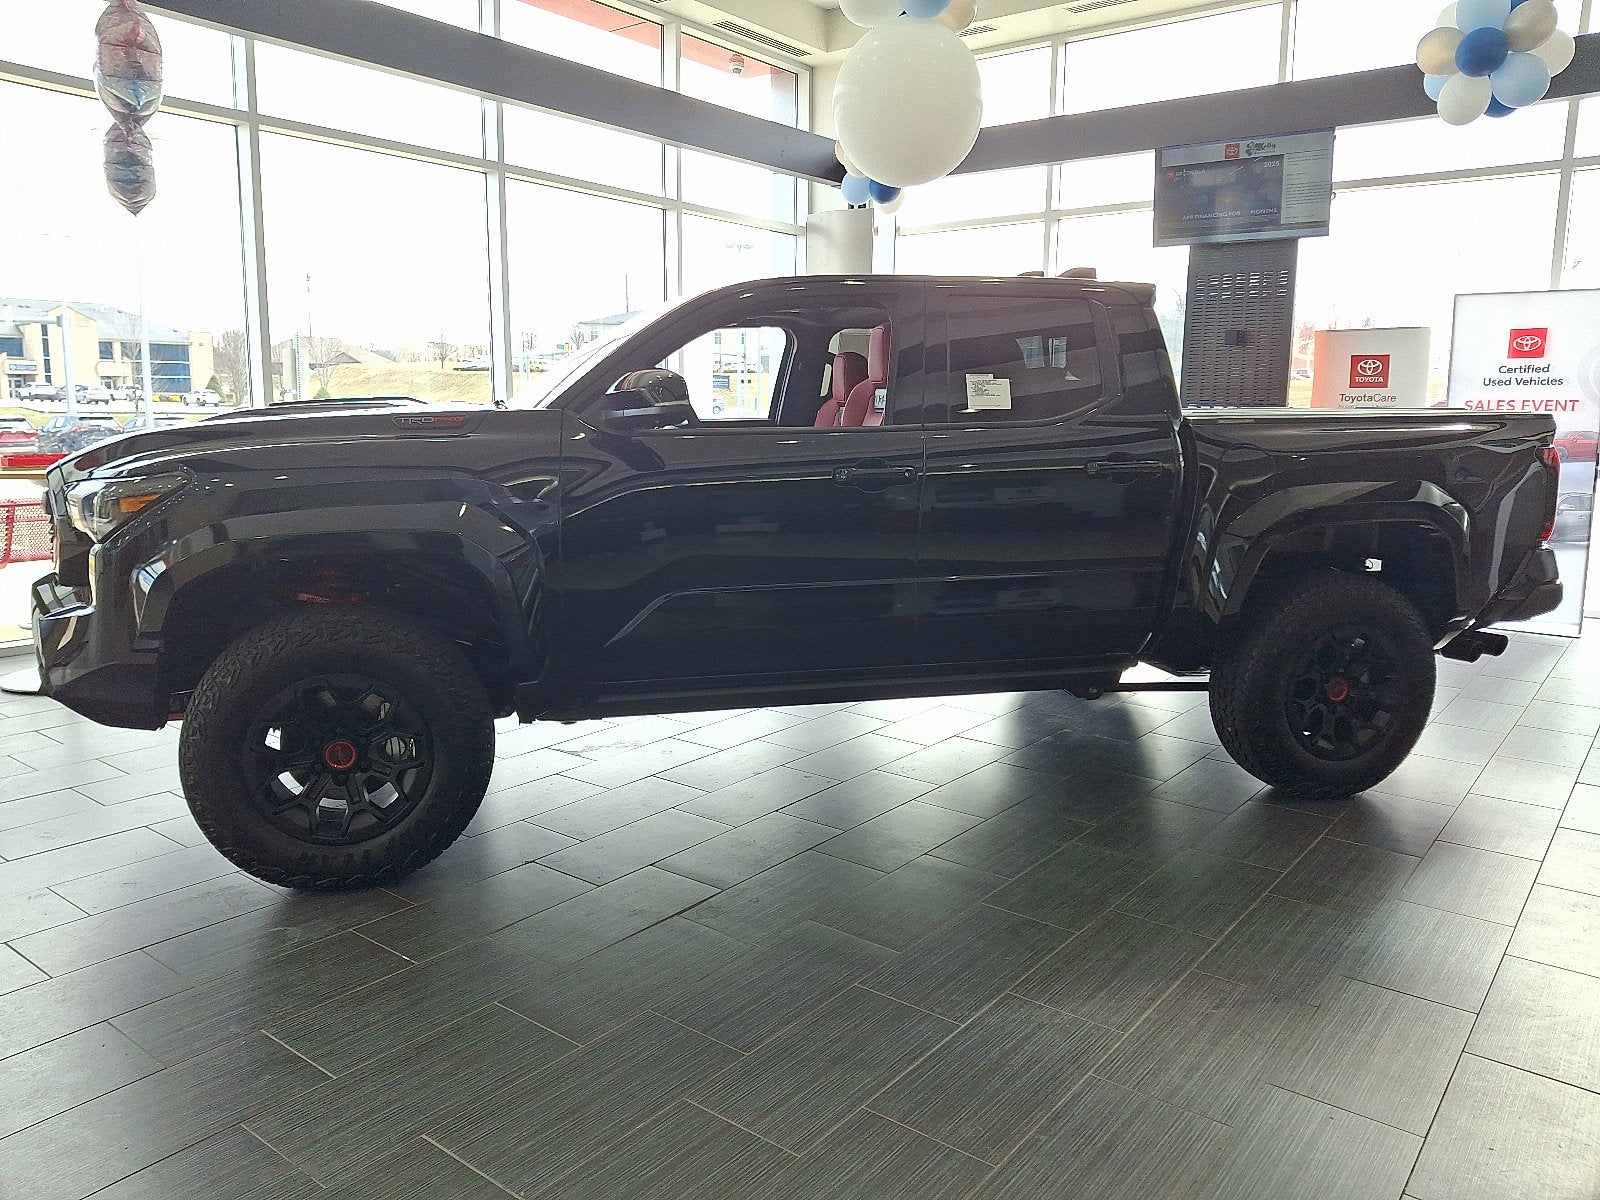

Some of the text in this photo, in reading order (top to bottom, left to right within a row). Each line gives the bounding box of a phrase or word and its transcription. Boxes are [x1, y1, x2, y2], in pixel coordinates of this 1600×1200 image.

[1498, 363, 1550, 374] Certified
[1483, 376, 1564, 386] Used Vehicles
[1339, 393, 1397, 404] ToyotaCare
[1464, 399, 1580, 412] SALES EVENT
